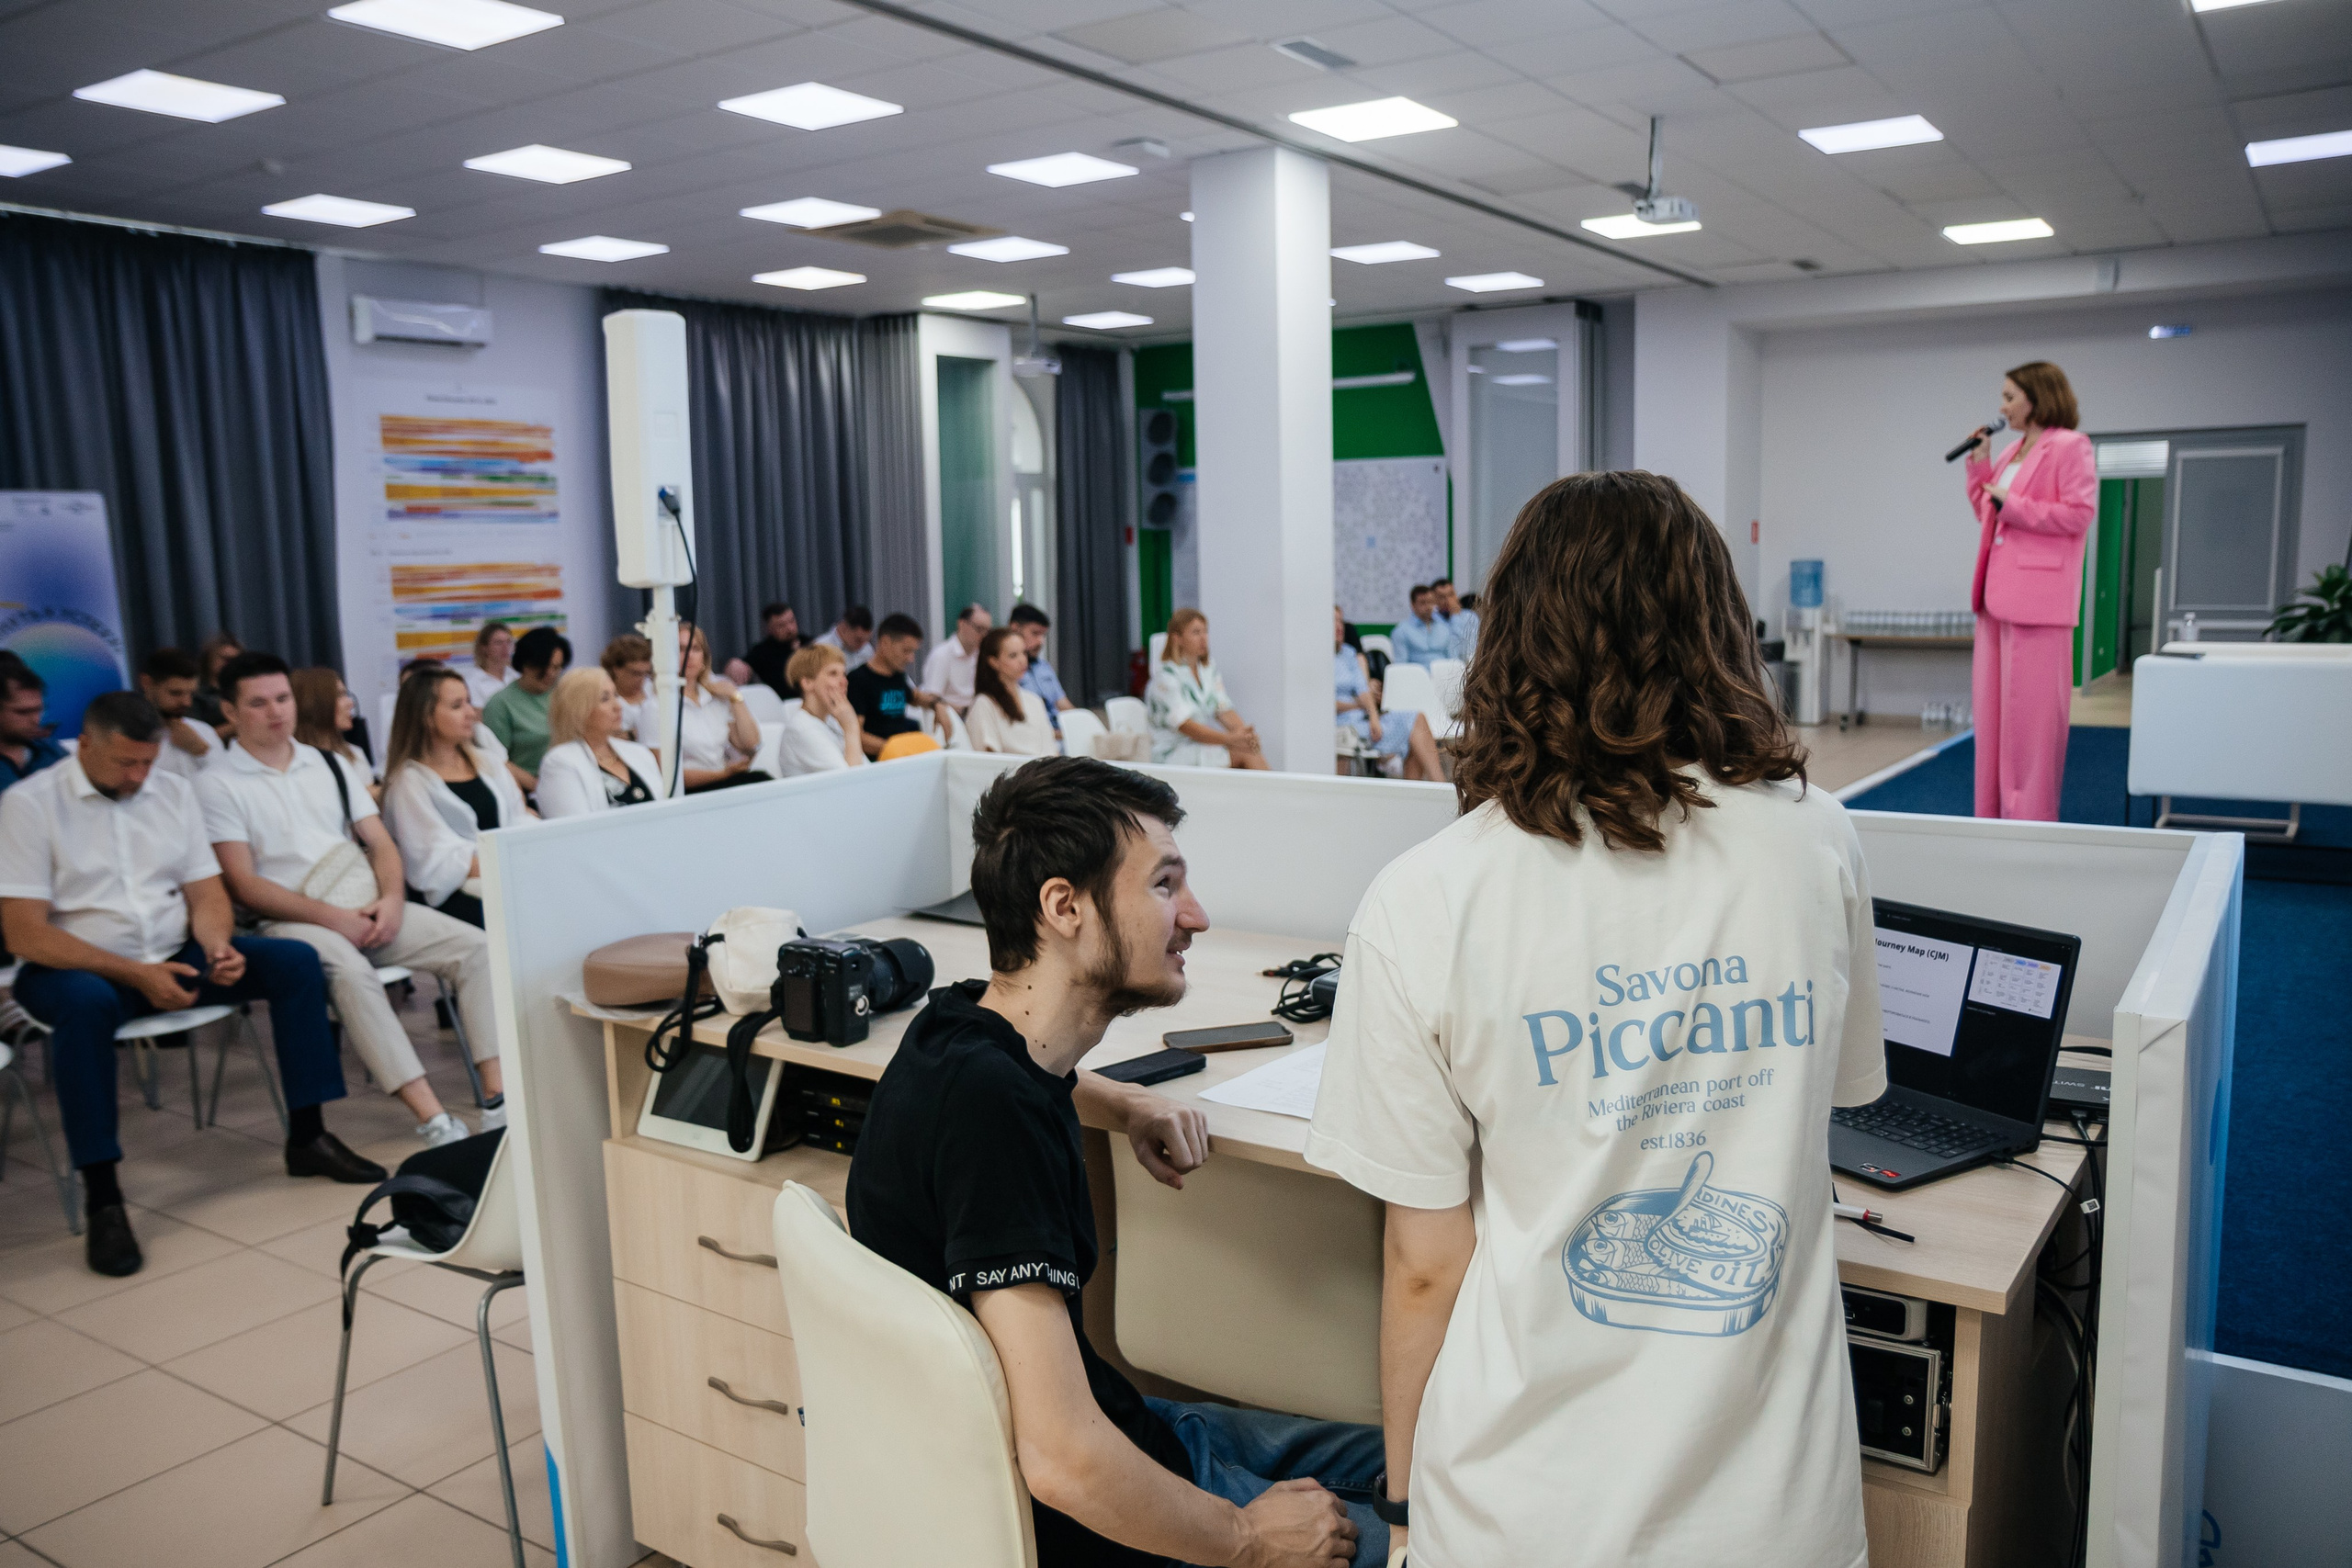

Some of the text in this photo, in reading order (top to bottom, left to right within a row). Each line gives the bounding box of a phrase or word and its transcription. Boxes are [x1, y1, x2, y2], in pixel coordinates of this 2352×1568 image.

[1907, 945, 1926, 957] Map
[1927, 949, 1950, 962] (CJM)
[1594, 954, 1748, 1007] Savona
[1522, 978, 1815, 1087] Piccanti
[1588, 1068, 1774, 1118] Mediterranean port off
[1615, 1093, 1746, 1132] the Riviera coast
[1640, 1130, 1707, 1150] est.1836
[1648, 1239, 1702, 1274] OLIVE
[977, 1268, 1007, 1285] SAY
